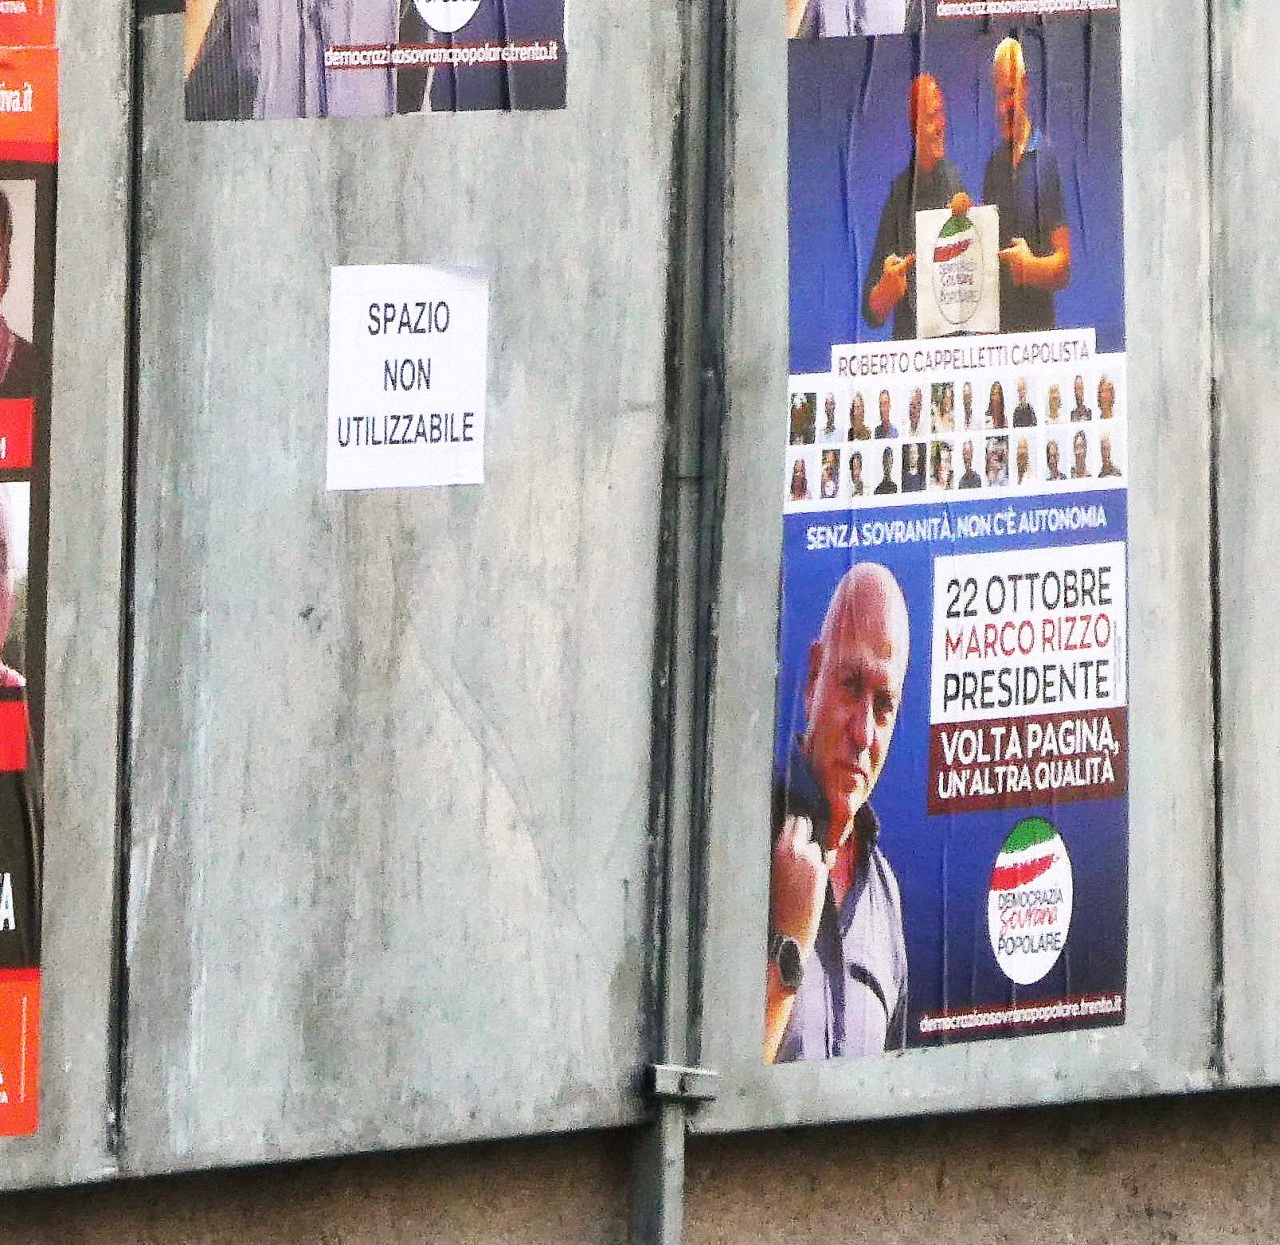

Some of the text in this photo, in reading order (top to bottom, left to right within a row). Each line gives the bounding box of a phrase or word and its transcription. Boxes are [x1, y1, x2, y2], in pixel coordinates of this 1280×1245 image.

[368, 301, 450, 335] SPAZIO
[384, 358, 431, 391] NON
[837, 340, 1090, 378] ROBERTO CAPPELLETTI CAPOLISTA
[337, 412, 474, 447] UTILIZZABILE
[806, 523, 860, 551] SENZA
[862, 512, 956, 545] SOVRANITÀ,
[956, 515, 992, 538] NON
[1019, 505, 1107, 533] AUTONOMIA
[946, 566, 1113, 618] 22 OTTOBRE
[945, 613, 1112, 661] MARCO RIZZO
[943, 659, 1110, 713] PRESIDENTE
[940, 716, 1120, 766] VOLTA PAGINA,
[937, 750, 1115, 799] UN'ALTRA QUALITÀ
[997, 885, 1064, 910] DEMOCRAZIA
[998, 931, 1063, 956] POPOLARE
